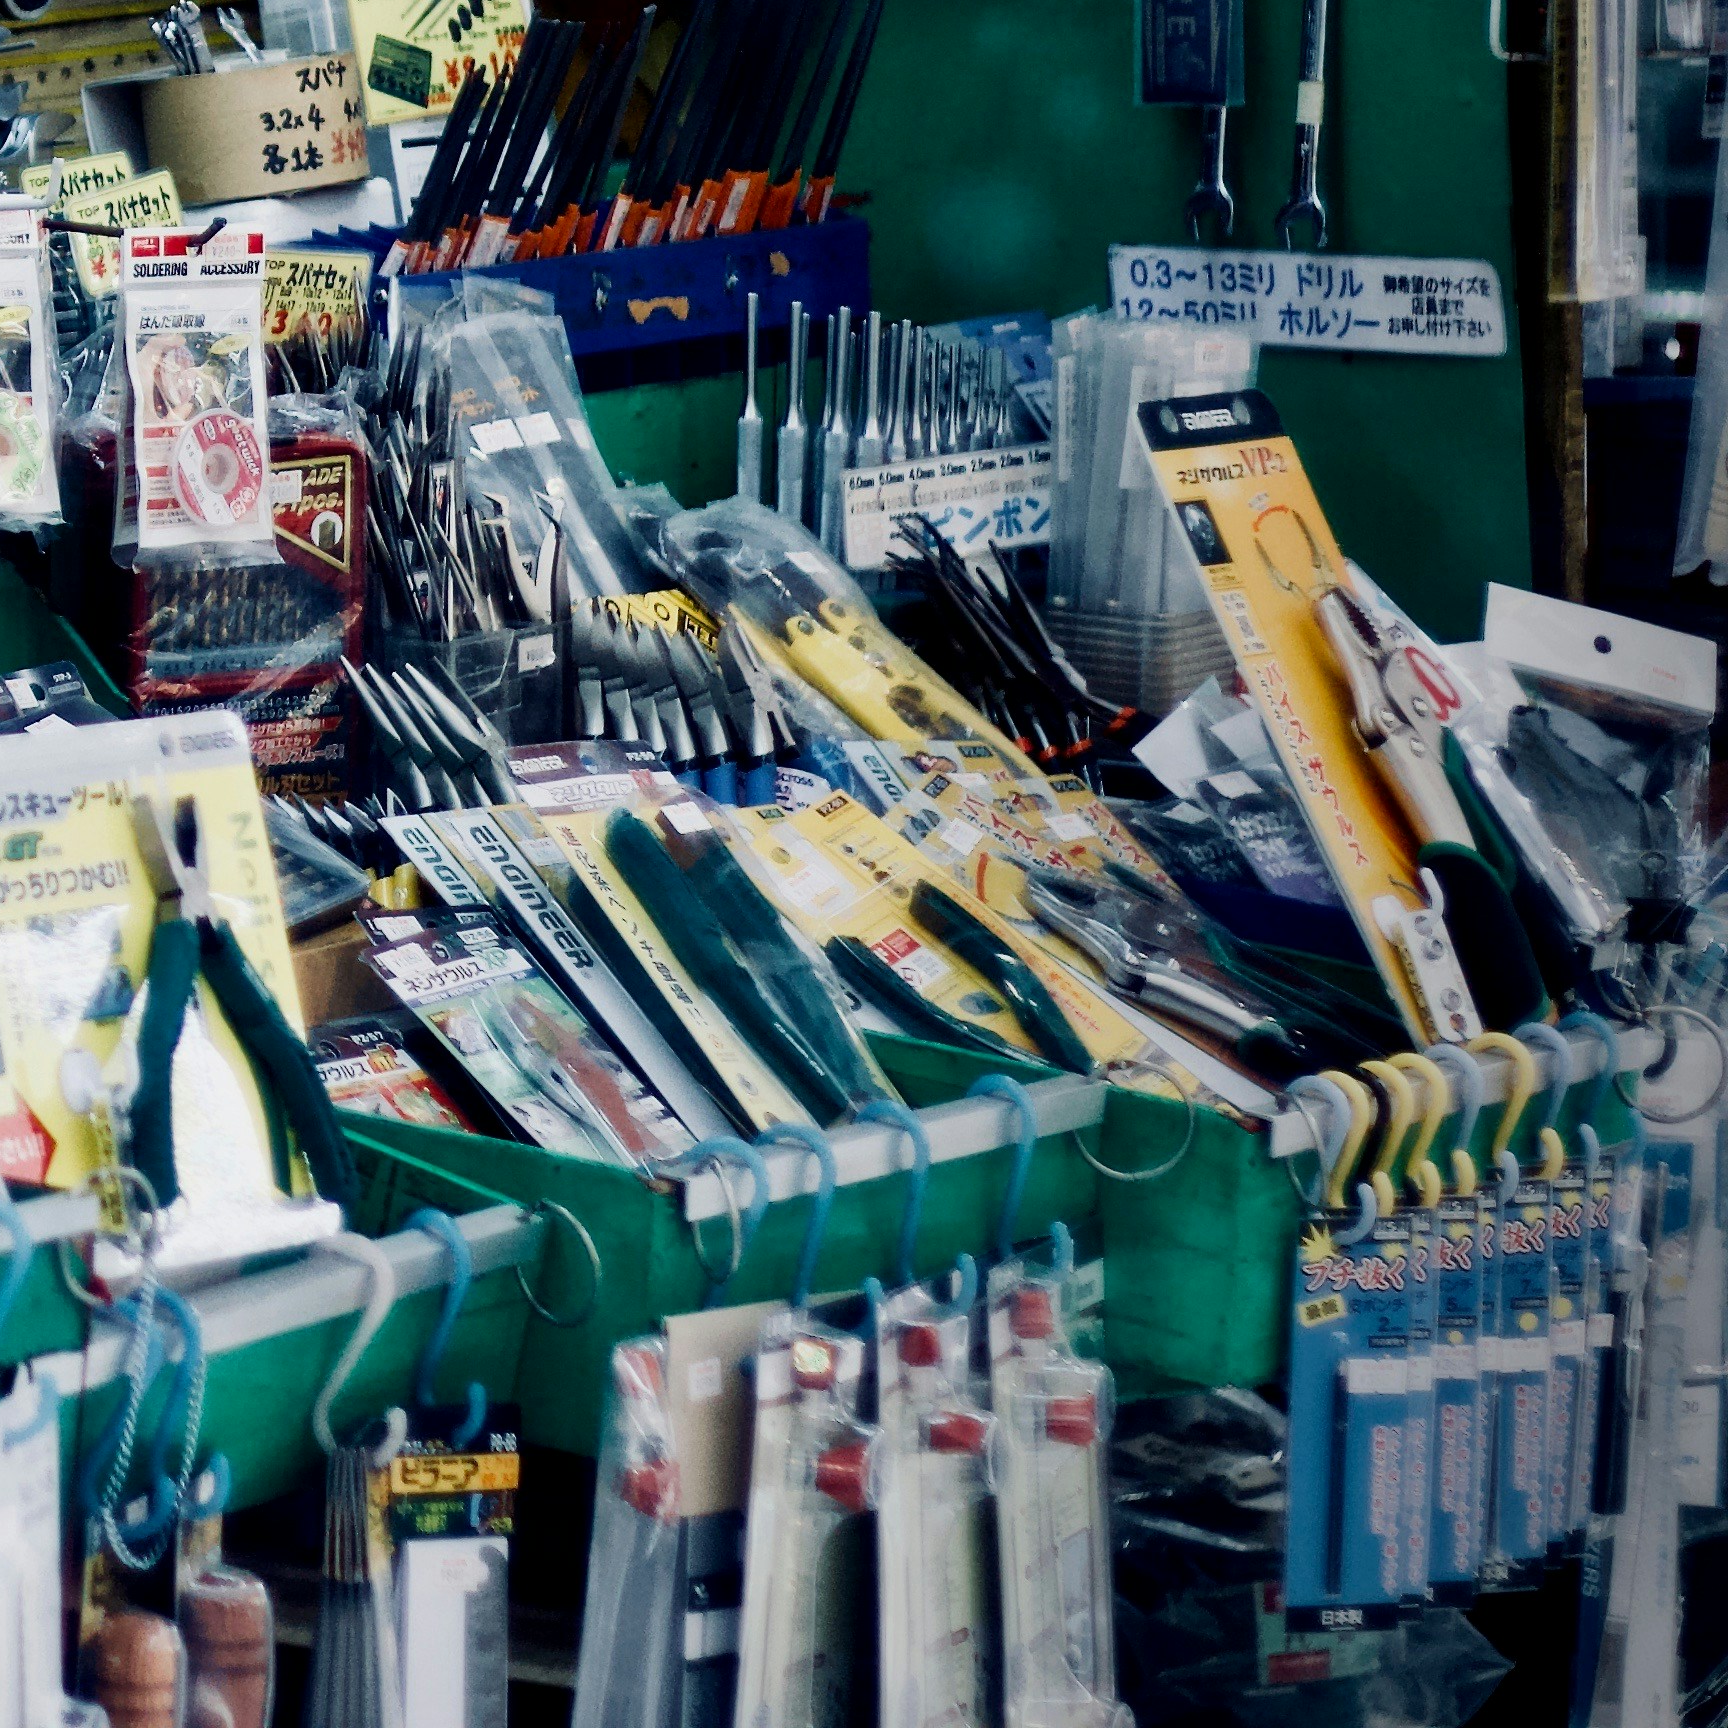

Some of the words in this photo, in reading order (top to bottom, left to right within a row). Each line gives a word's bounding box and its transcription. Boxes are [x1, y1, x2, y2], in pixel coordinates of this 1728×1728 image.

[295, 61, 347, 93] スパナ
[28, 175, 50, 188] TOP
[77, 206, 100, 218] TOP
[104, 185, 171, 227] スパナセット
[133, 262, 188, 277] SOLDERING
[289, 261, 351, 290] スパナセッ
[1294, 263, 1364, 298] ドリル
[139, 313, 206, 330] はんだ吸取線
[1278, 305, 1382, 339] ホルソー
[1177, 462, 1244, 486] ネジザウルス
[401, 825, 481, 905] ENGIN
[469, 824, 594, 969] ENGINEER
[404, 961, 485, 992] ネジザウルス
